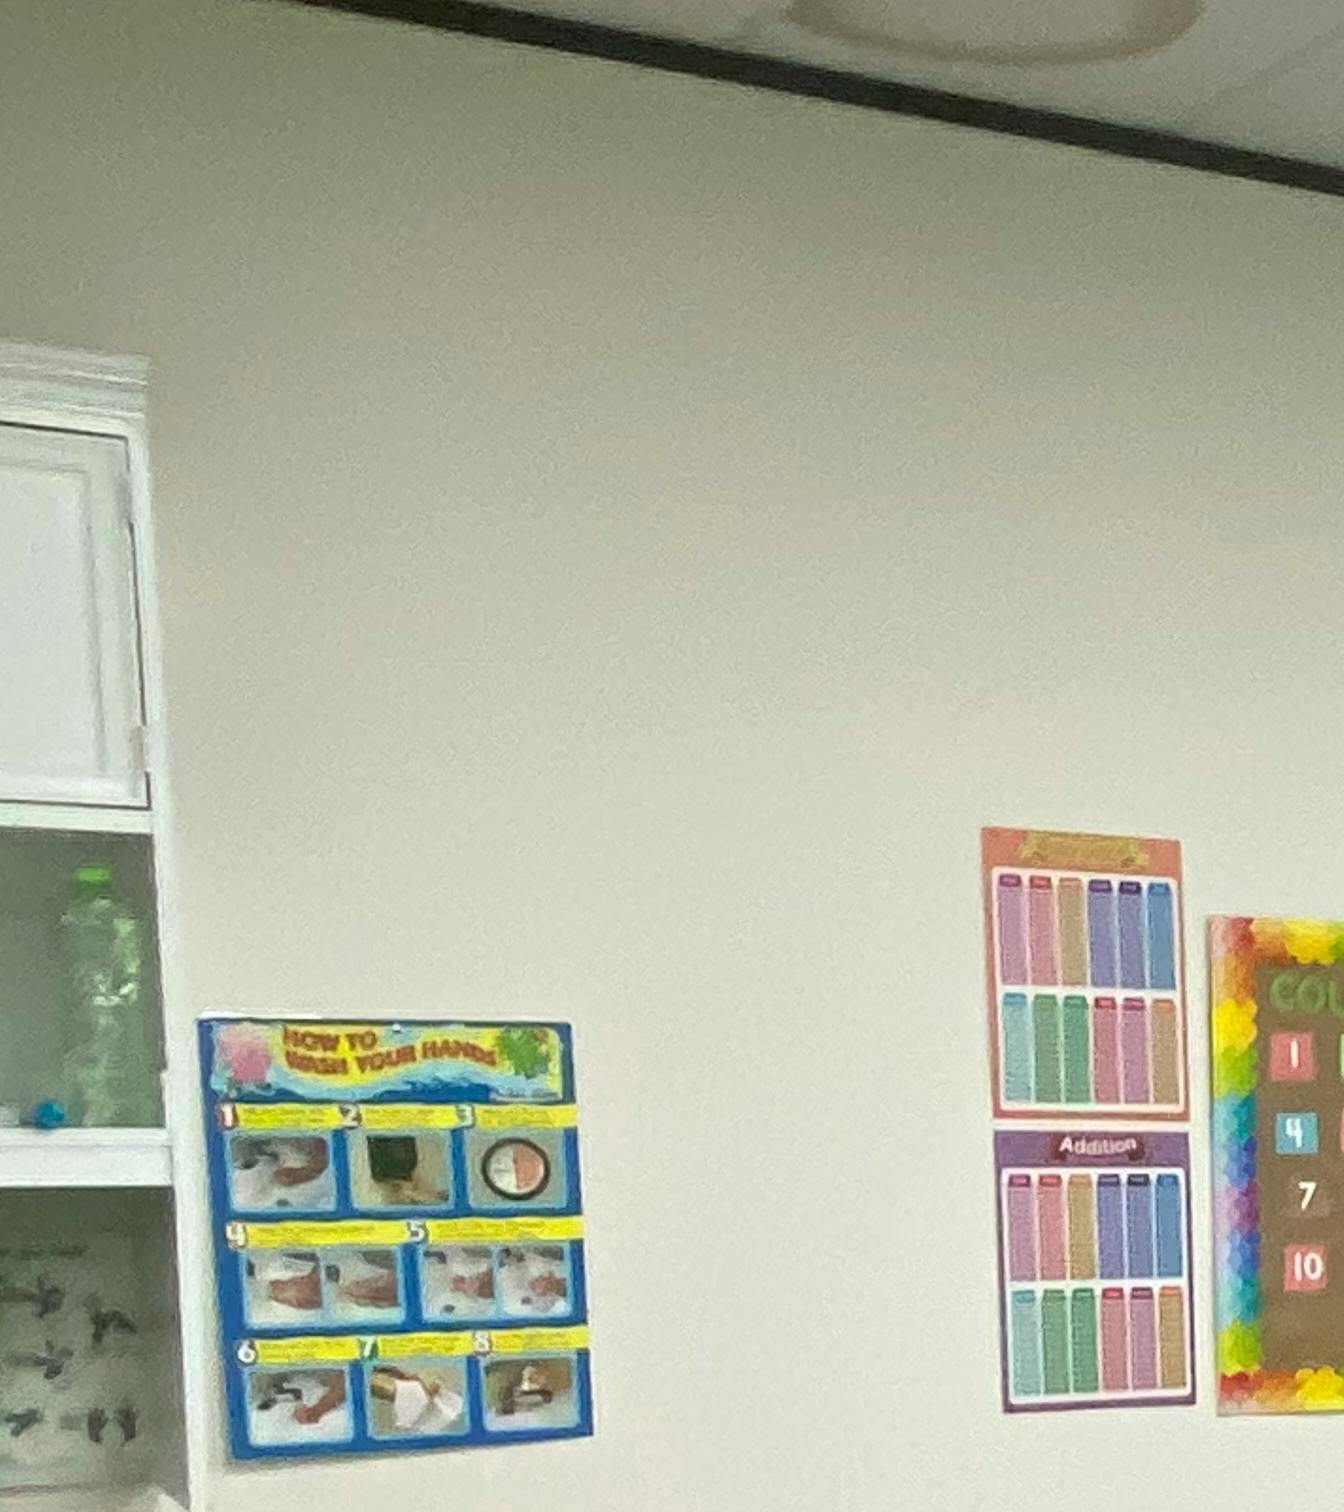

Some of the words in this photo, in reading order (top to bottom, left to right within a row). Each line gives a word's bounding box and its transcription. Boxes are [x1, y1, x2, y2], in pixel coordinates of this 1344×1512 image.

[1289, 1039, 1300, 1069] 1
[1059, 1136, 1138, 1157] Addition
[1285, 1115, 1302, 1148] 4
[1299, 1180, 1318, 1213] 7
[1293, 1252, 1324, 1281] 10
